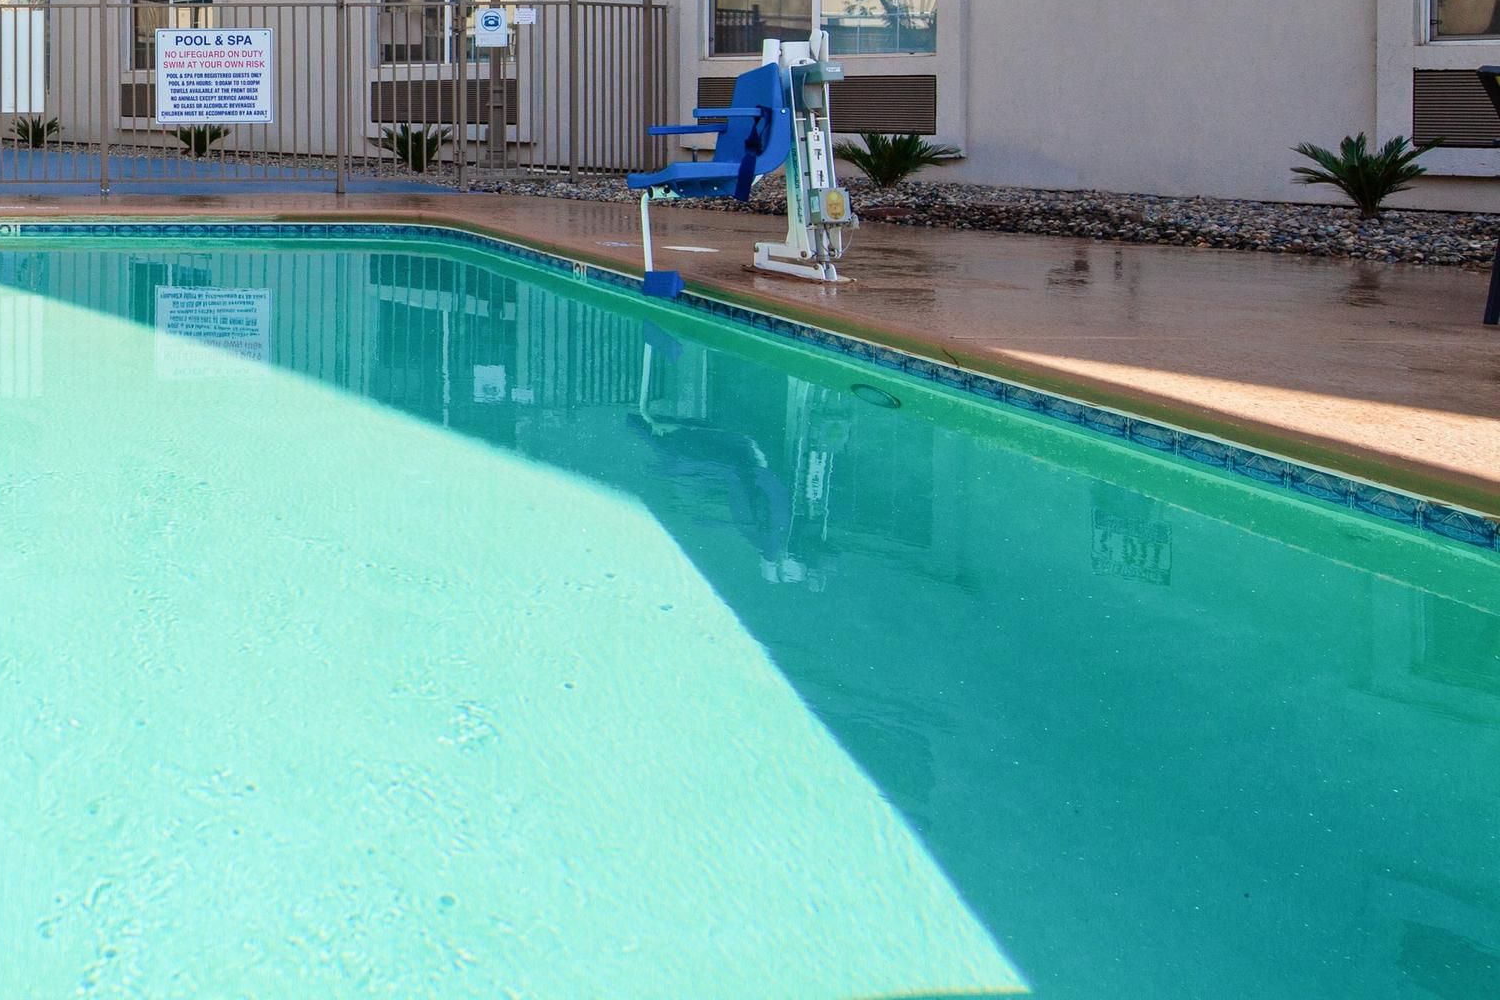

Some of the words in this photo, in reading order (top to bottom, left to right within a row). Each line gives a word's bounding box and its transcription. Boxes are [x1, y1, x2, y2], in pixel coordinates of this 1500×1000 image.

[176, 36, 210, 46] POOL
[215, 36, 223, 45] &
[228, 35, 252, 45] SPA
